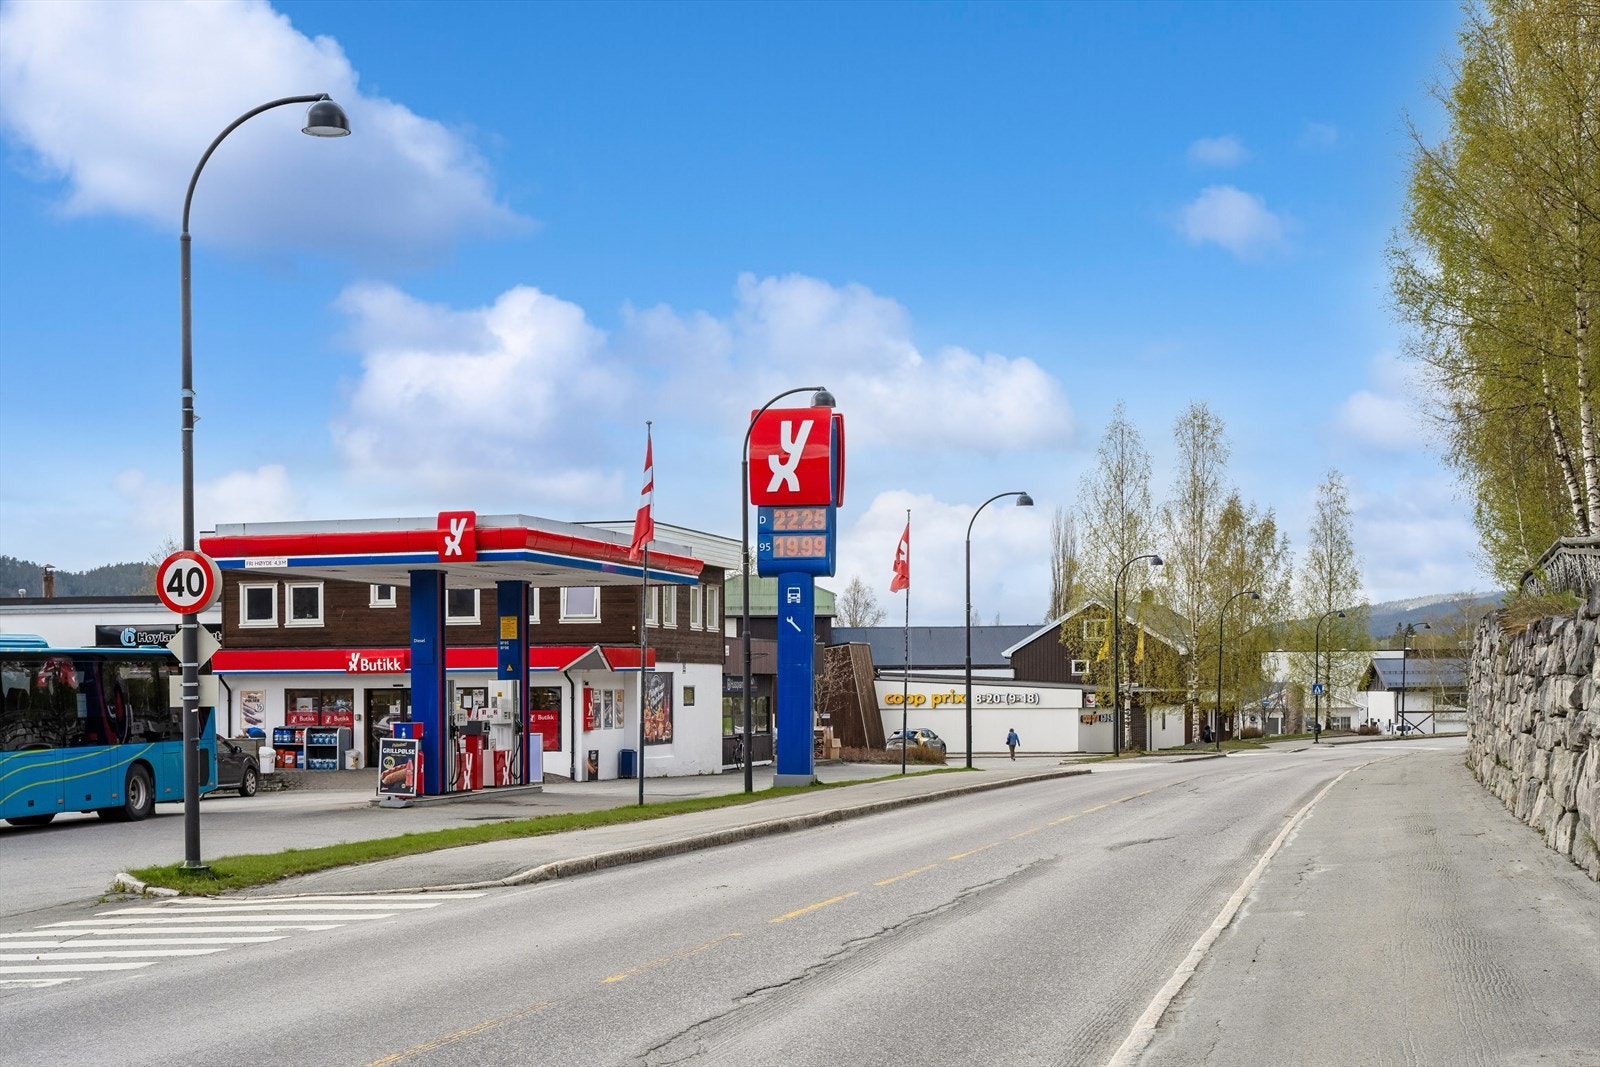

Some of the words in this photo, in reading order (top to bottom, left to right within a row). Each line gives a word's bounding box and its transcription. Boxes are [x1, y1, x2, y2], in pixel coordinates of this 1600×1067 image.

[759, 516, 766, 524] D
[774, 510, 825, 530] 22.25
[759, 543, 771, 551] 95
[775, 536, 825, 556] 19.99
[166, 567, 204, 597] 40
[360, 658, 401, 671] Butikk
[884, 693, 926, 707] coop
[931, 689, 966, 709] prix
[975, 693, 1001, 704] 8-20
[1005, 693, 1040, 705] (9-18)
[383, 747, 415, 755] GRILLPØLSE
